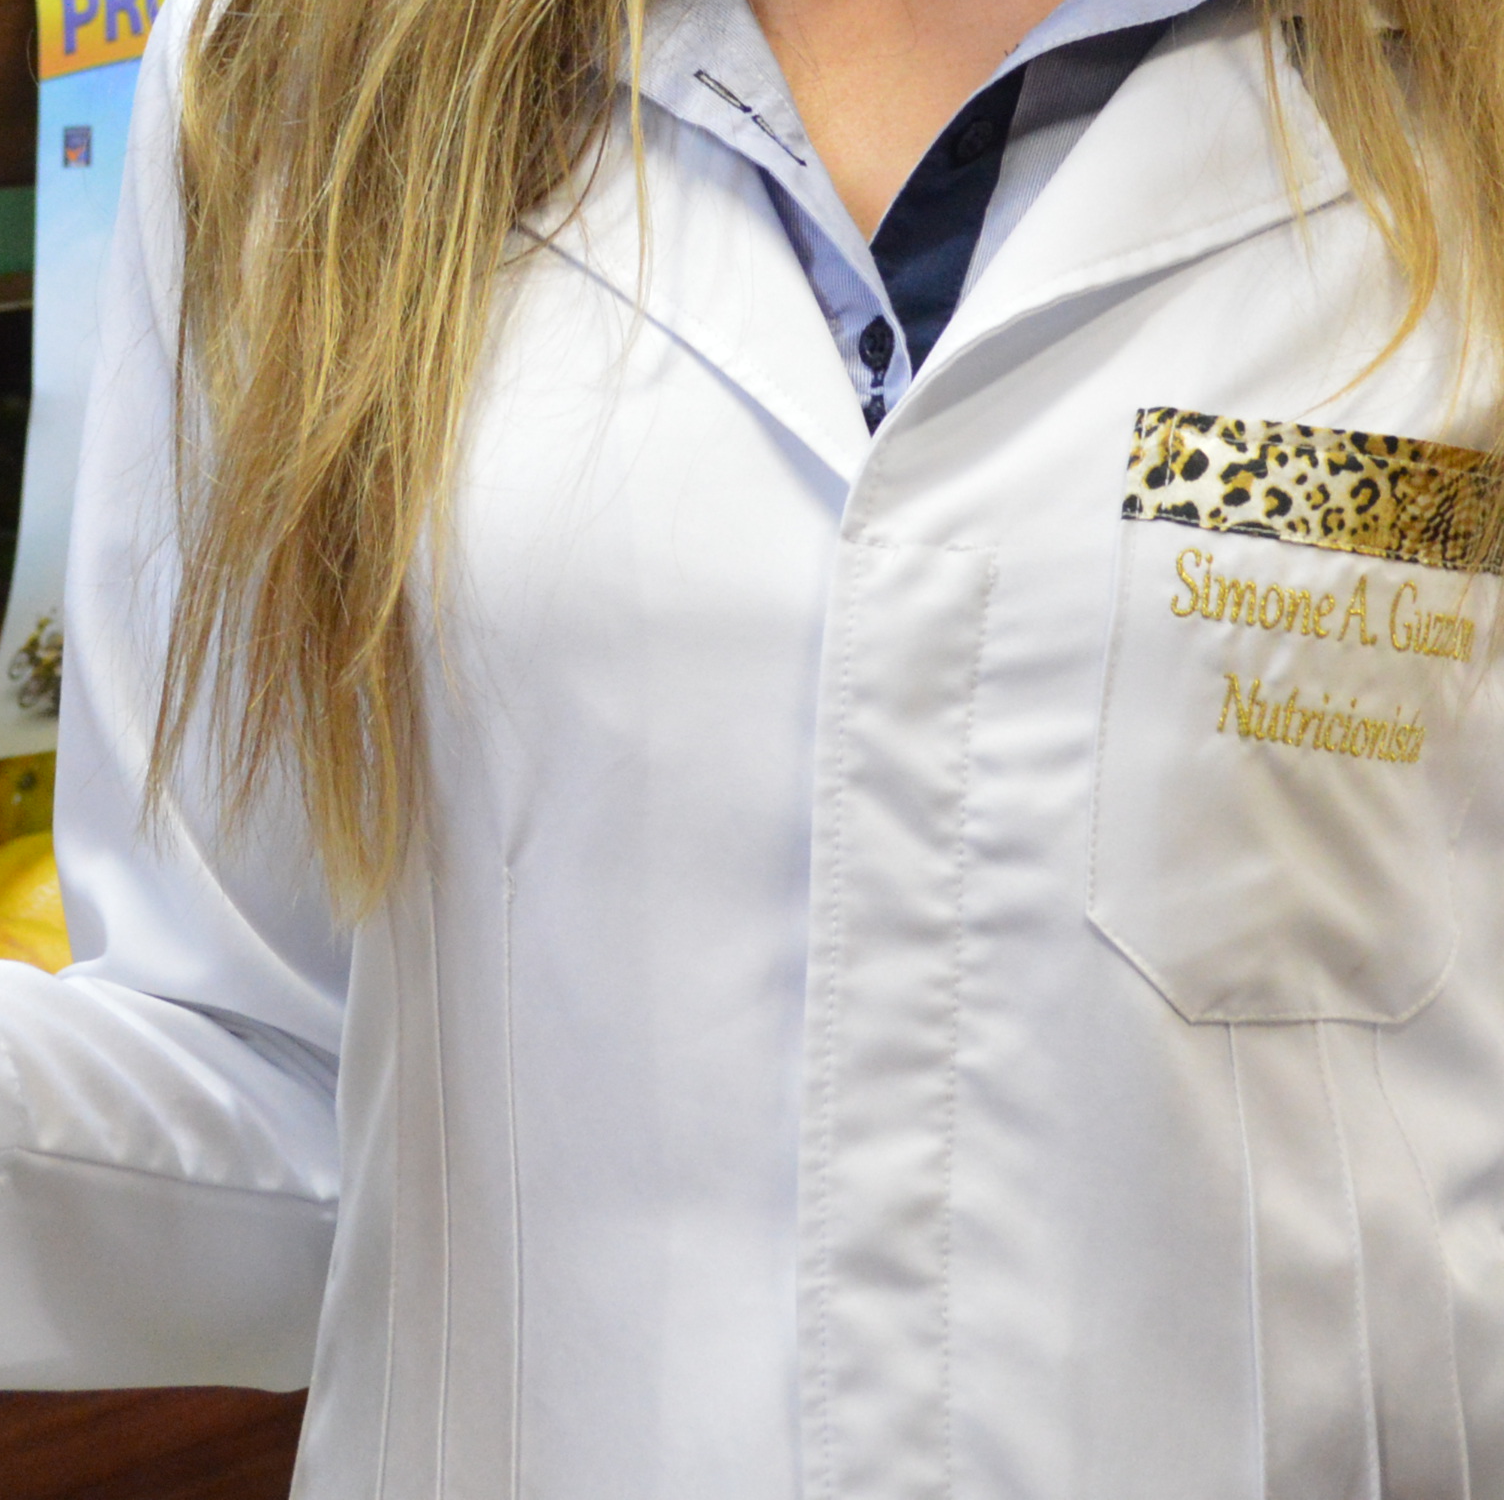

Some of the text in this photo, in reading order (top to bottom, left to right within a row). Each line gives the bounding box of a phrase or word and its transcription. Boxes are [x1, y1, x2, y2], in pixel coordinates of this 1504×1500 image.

[1170, 548, 1335, 639] Simone
[1336, 574, 1377, 646] A.
[1216, 672, 1427, 763] Nutricionista
